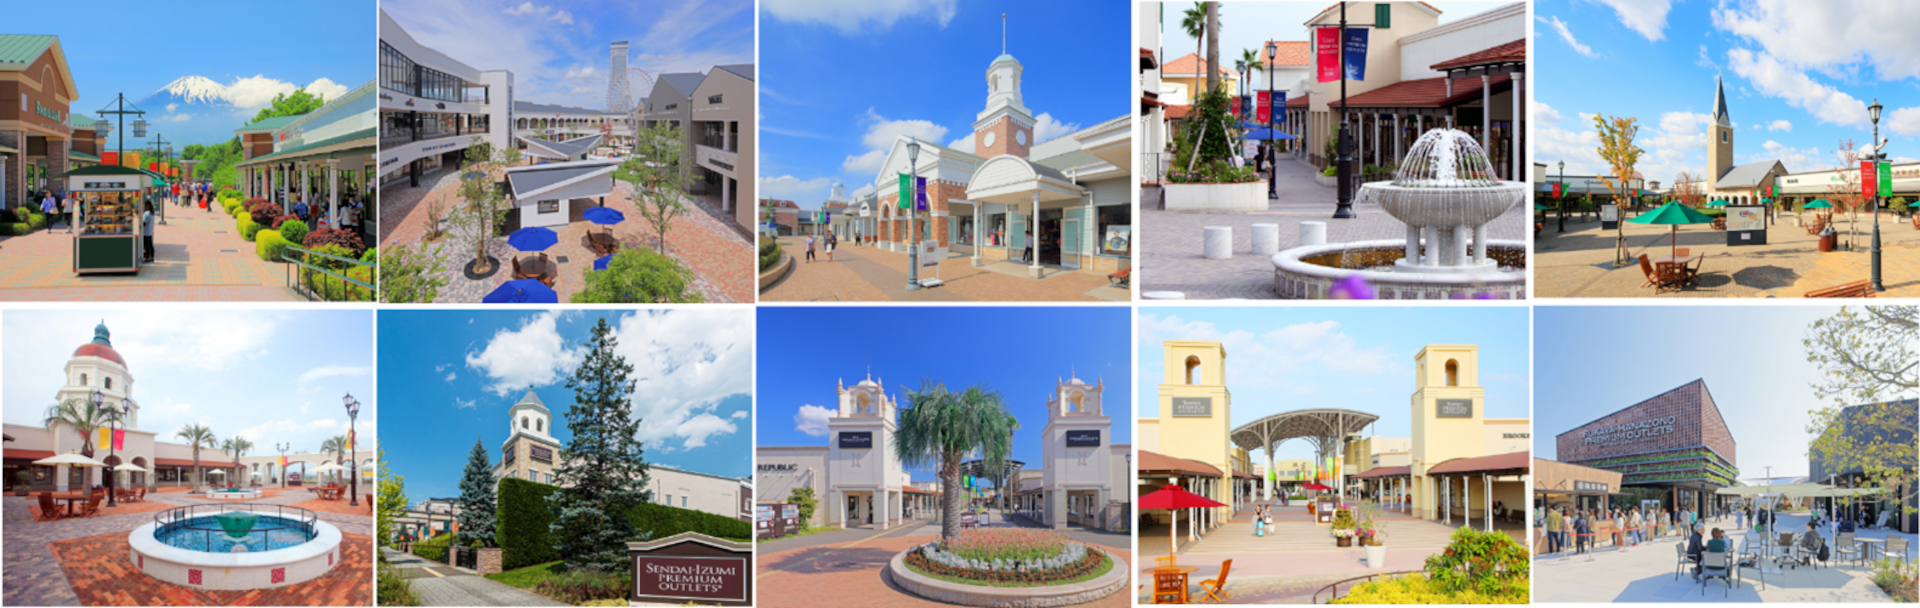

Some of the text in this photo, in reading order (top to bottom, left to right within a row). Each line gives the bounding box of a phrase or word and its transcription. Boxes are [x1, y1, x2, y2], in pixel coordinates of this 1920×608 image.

[1582, 415, 1676, 438] FUKAYA-HANAZONO
[1584, 431, 1626, 445] PREMIUM
[757, 463, 799, 472] REPUBLIC
[658, 573, 723, 585] PREMIUM
